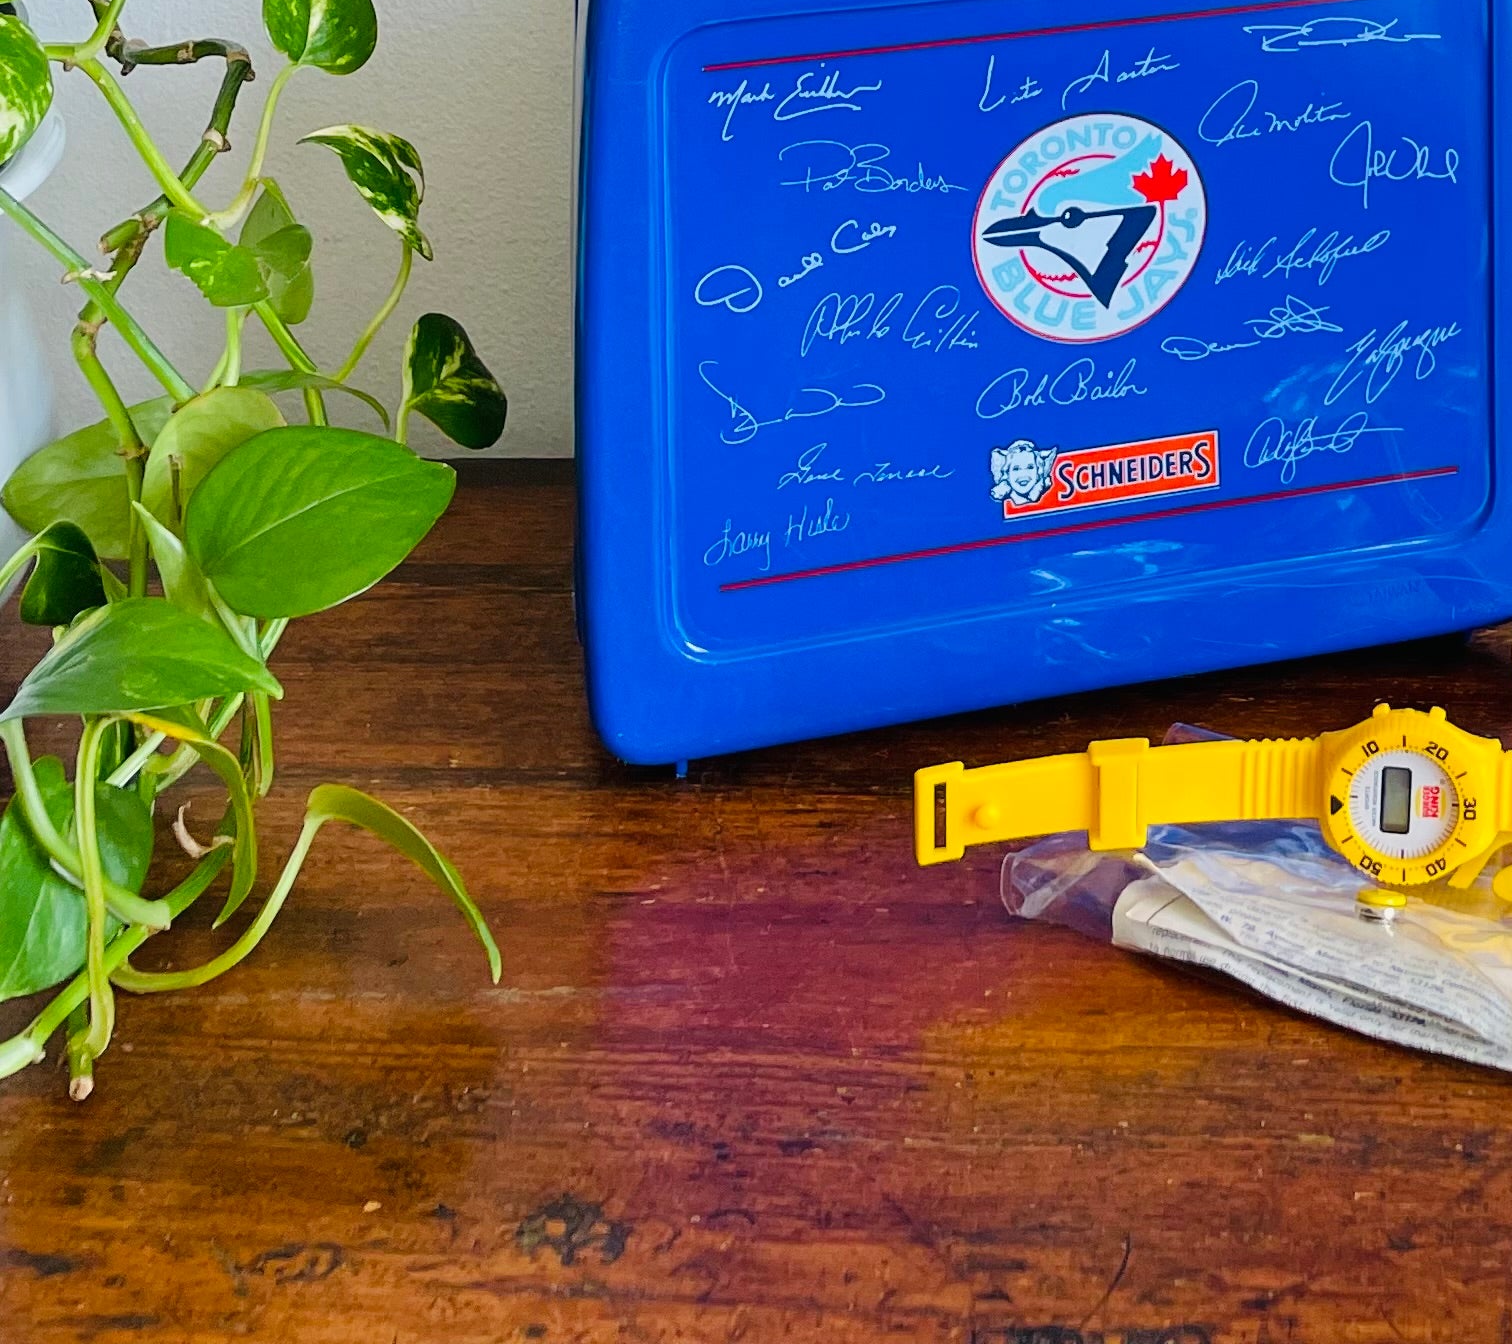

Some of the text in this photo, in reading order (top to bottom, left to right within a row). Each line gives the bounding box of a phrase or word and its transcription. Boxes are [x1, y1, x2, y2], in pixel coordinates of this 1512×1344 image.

[989, 122, 1137, 210] TORONTO
[991, 255, 1097, 330] BLUE
[1116, 210, 1197, 321] JAYS
[1055, 440, 1212, 501] SCHNEIDERS
[1361, 740, 1380, 758] 10
[1424, 741, 1449, 761] 20
[1431, 786, 1441, 818] KING
[1463, 797, 1477, 821] 30
[1359, 855, 1383, 877] 50
[1425, 857, 1447, 877] 40
